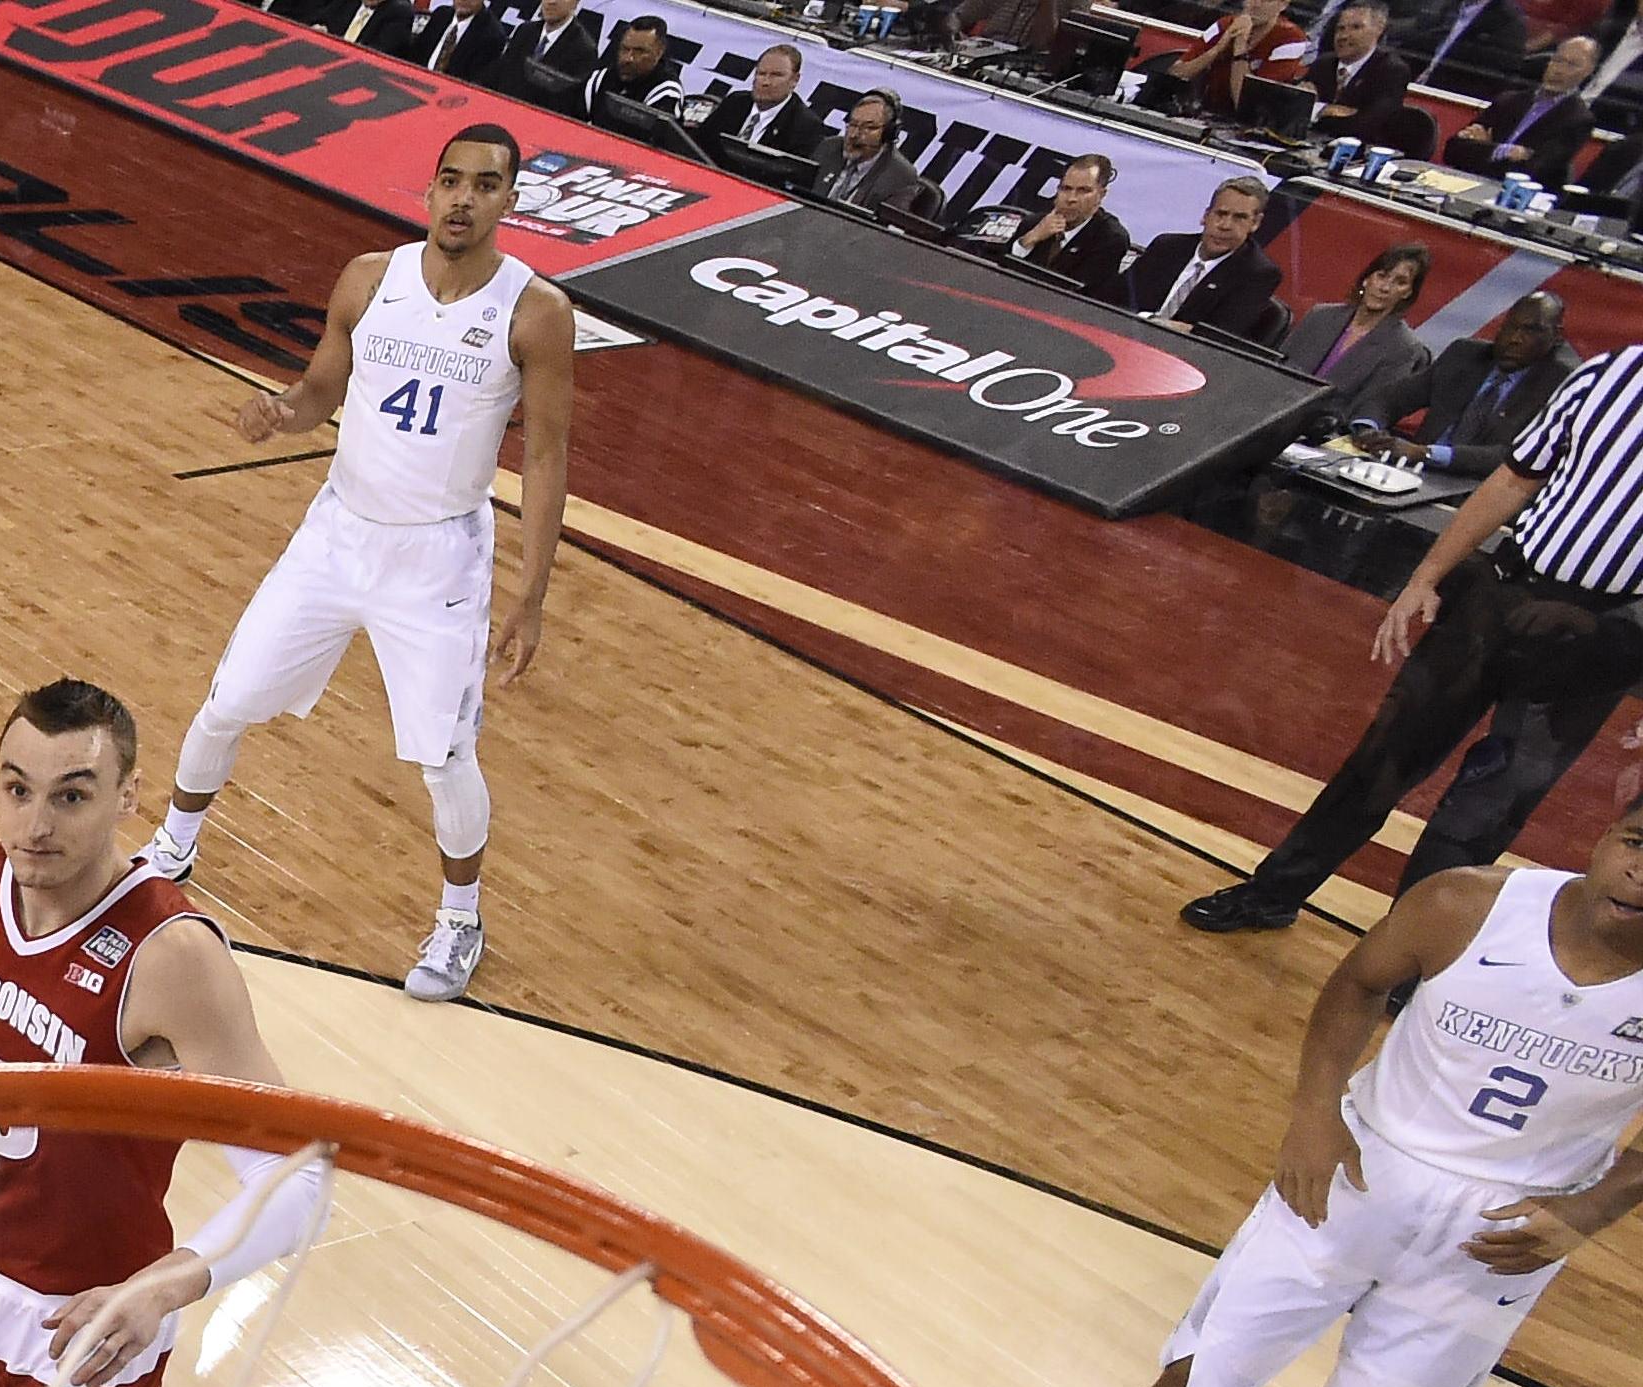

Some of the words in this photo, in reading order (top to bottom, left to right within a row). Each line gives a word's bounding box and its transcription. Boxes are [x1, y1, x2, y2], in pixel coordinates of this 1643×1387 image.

[363, 334, 492, 385] KENTUCKY
[379, 378, 445, 436] 41
[1468, 1065, 1548, 1131] 2
